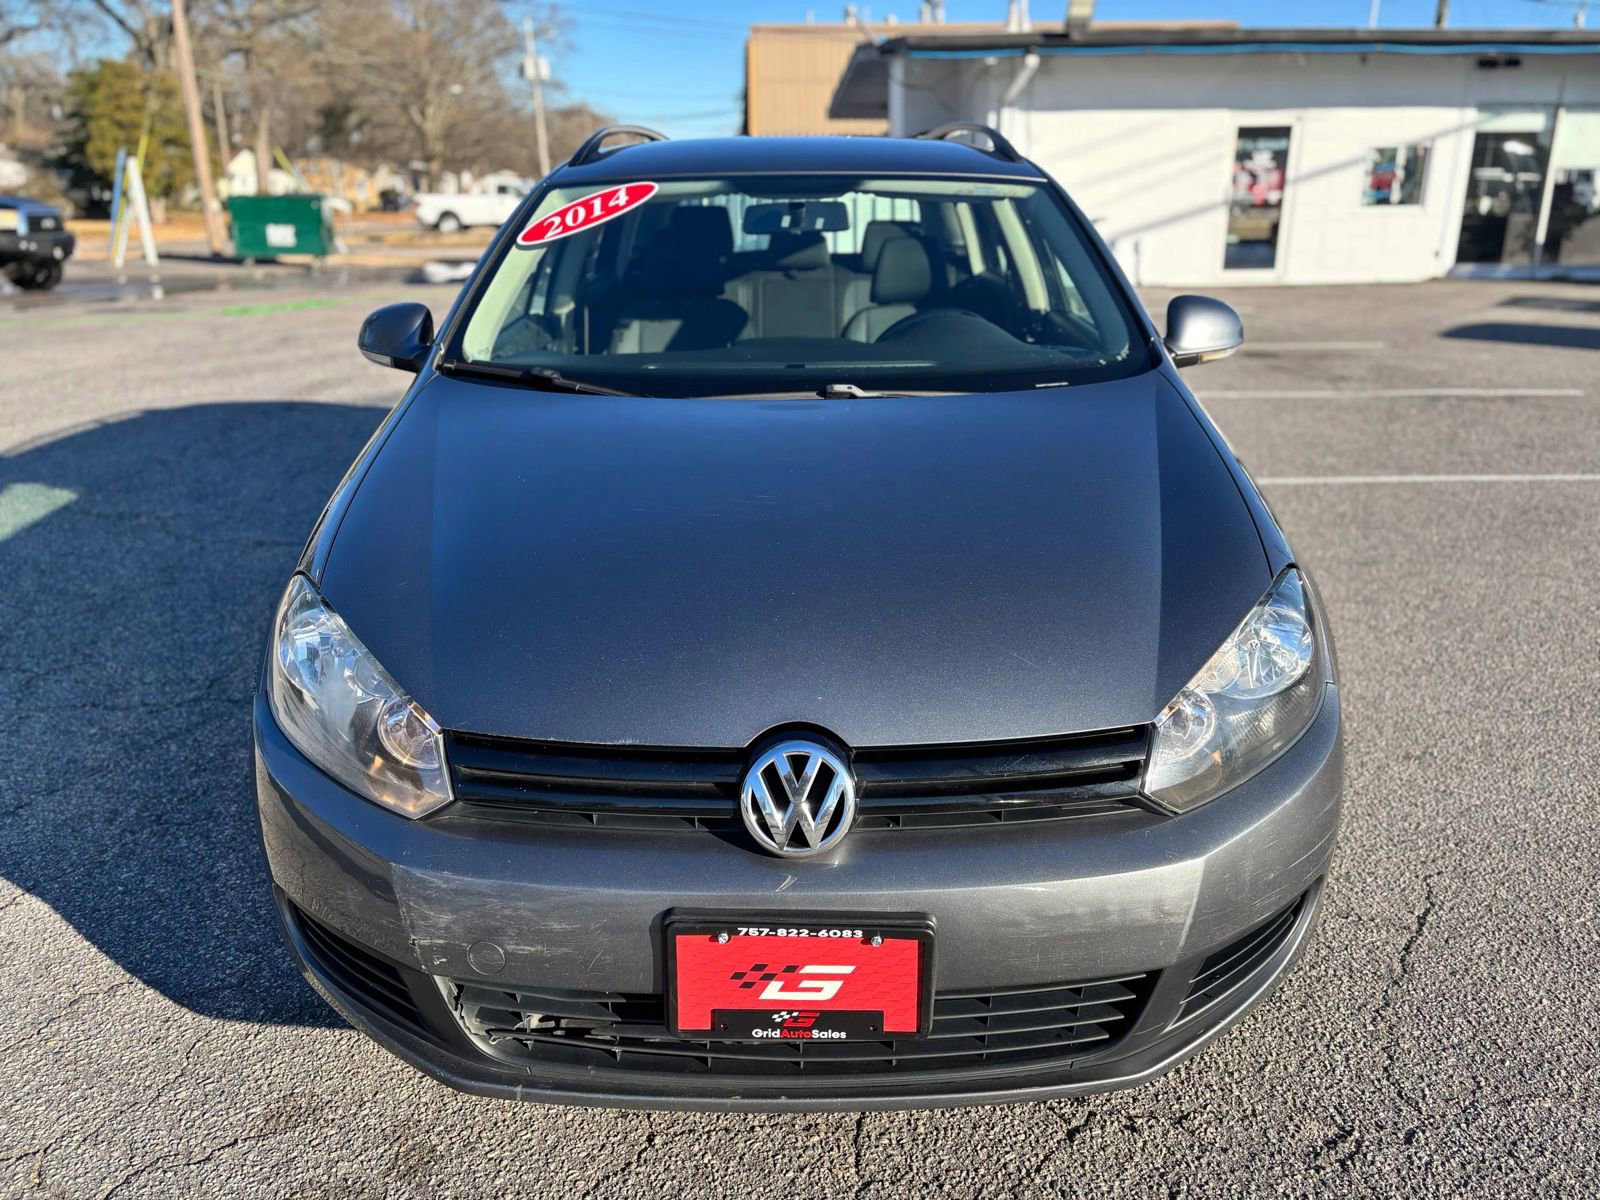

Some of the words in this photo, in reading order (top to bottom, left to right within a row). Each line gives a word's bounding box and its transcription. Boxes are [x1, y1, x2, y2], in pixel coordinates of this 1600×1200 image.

[543, 187, 629, 239] 2014
[745, 746, 850, 853] VW
[737, 927, 863, 938] 757-822-6083
[751, 1028, 847, 1039] GridAutoSales
